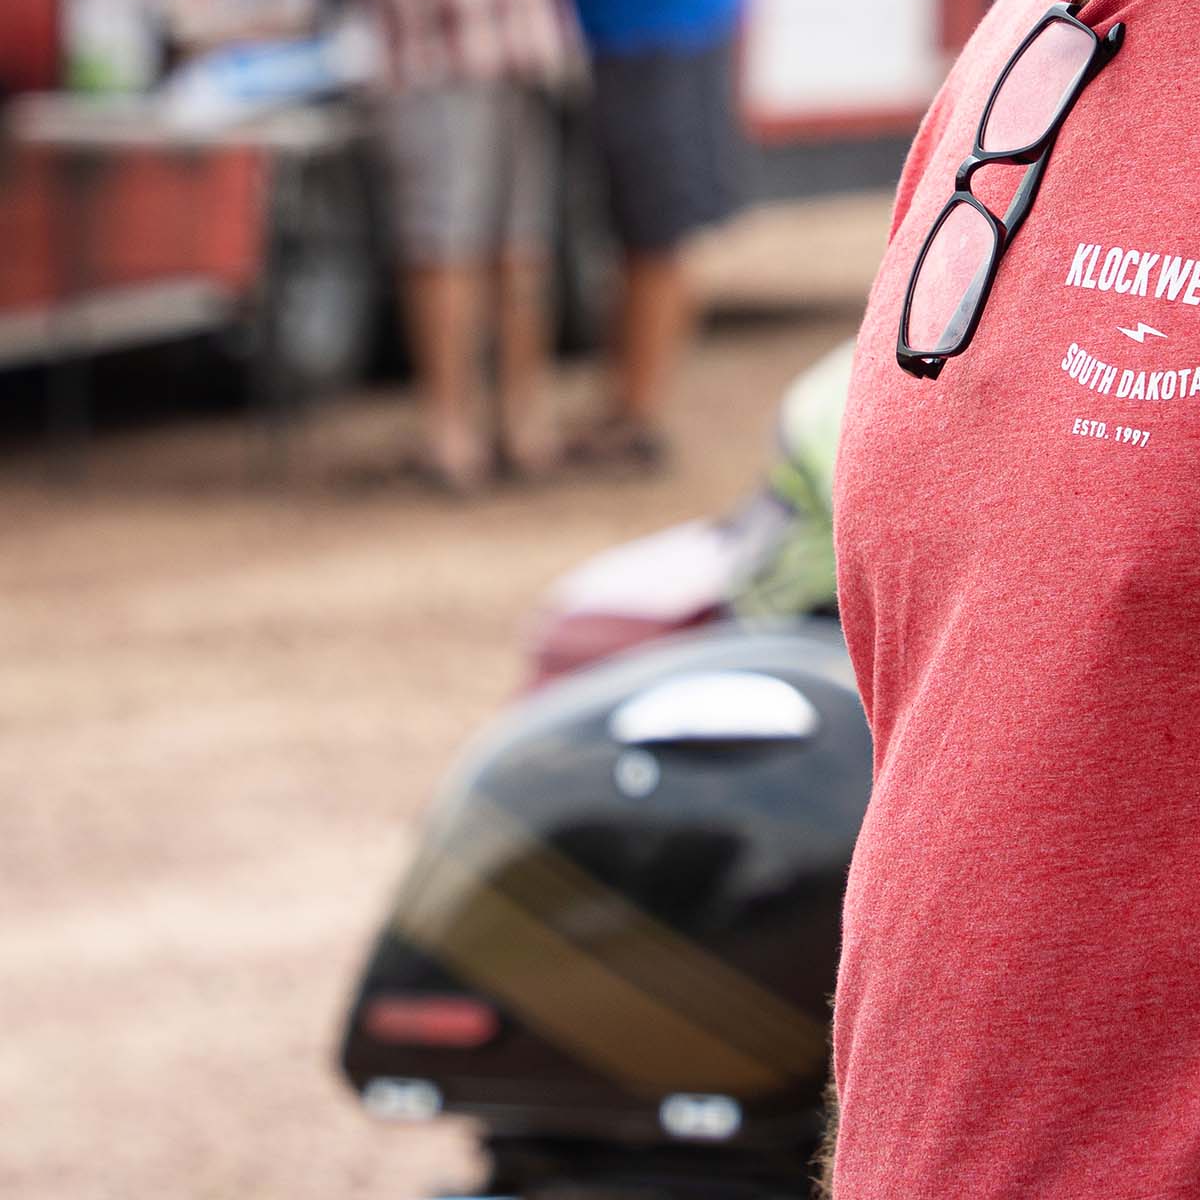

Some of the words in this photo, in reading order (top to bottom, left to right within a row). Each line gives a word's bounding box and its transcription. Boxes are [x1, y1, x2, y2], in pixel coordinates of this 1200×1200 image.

[1060, 342, 1118, 395] SOUTH
[1071, 417, 1110, 440] ESTD.
[1114, 425, 1151, 448] 1997
